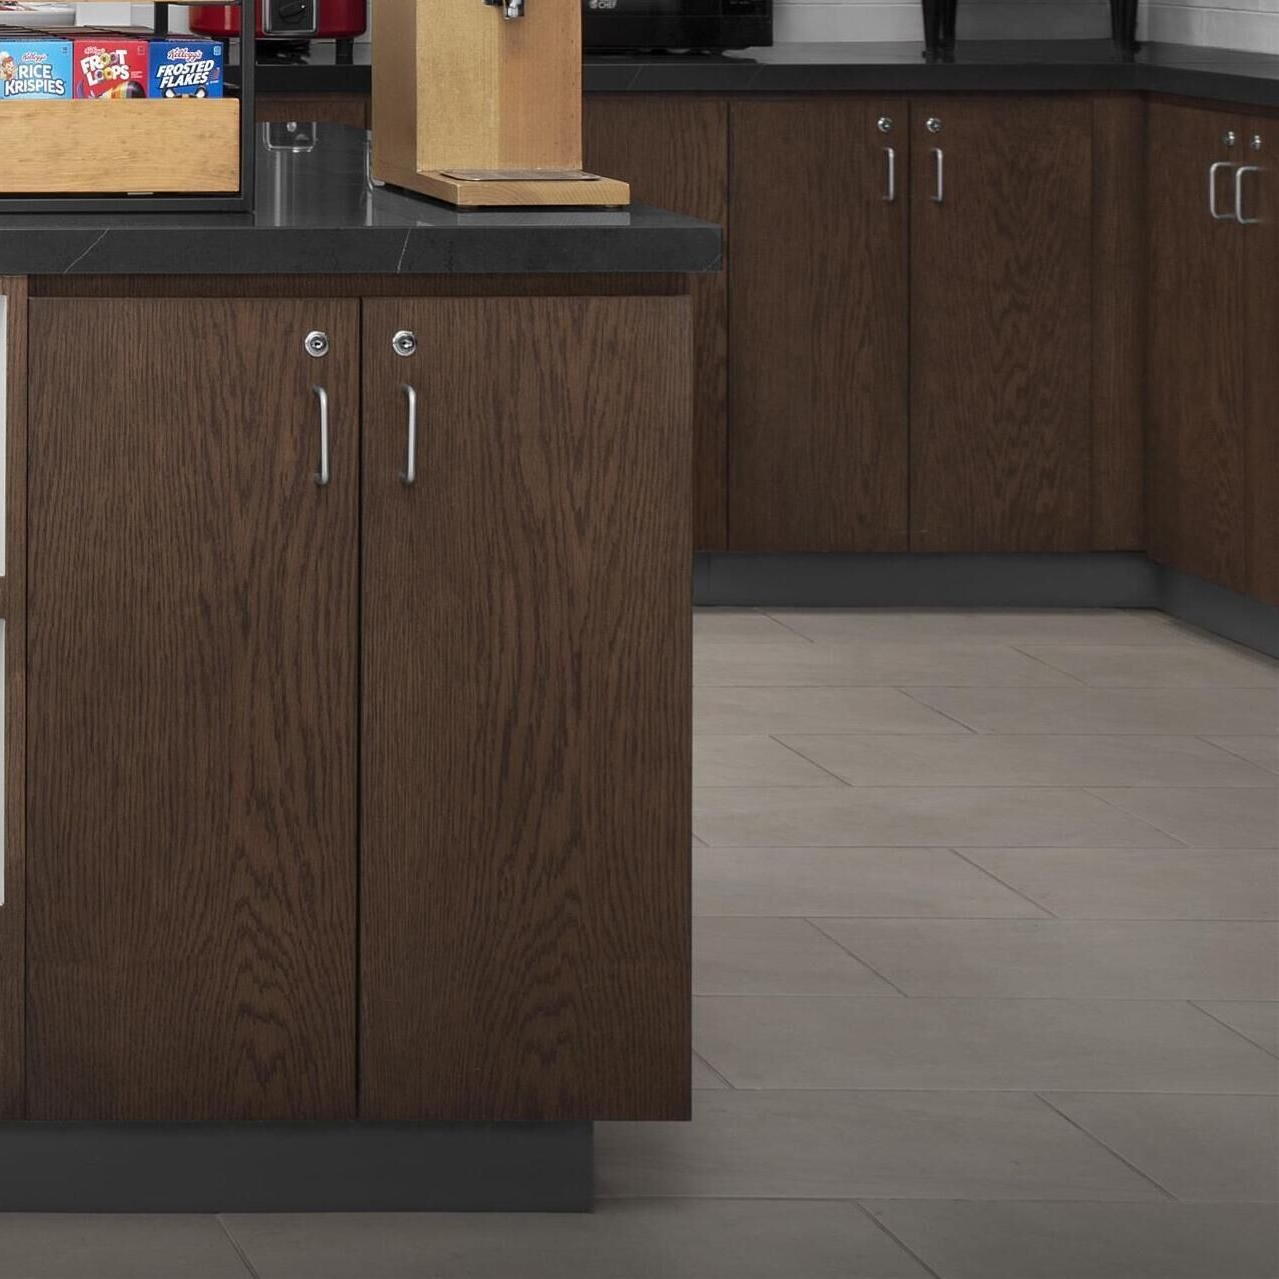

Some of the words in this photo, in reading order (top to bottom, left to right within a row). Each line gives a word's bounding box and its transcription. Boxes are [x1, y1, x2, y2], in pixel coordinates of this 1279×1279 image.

[80, 49, 128, 74] FROOT
[167, 47, 203, 62] Kellogg's
[18, 64, 52, 79] RICE
[85, 64, 130, 86] LOOPS
[156, 60, 215, 78] FROSTED
[5, 79, 65, 96] KRISPIES
[159, 71, 209, 89] FLAKES
